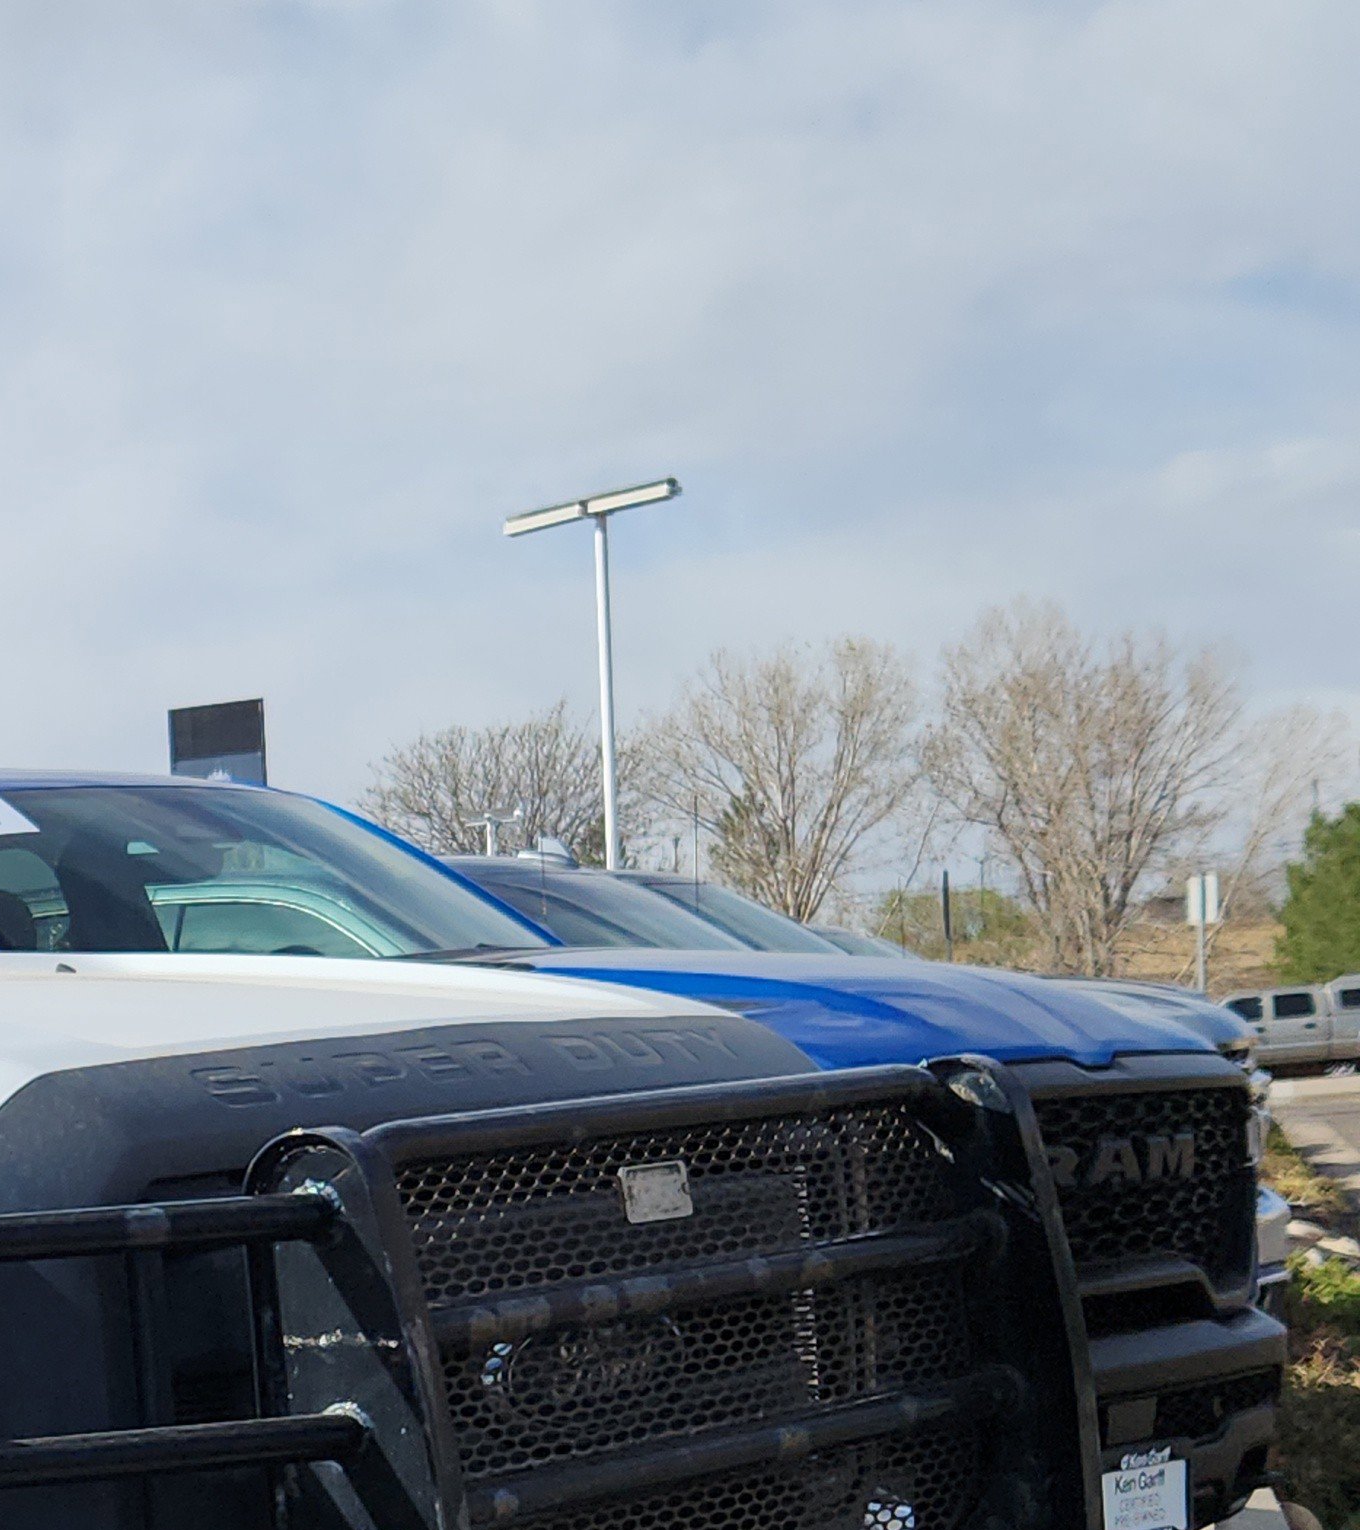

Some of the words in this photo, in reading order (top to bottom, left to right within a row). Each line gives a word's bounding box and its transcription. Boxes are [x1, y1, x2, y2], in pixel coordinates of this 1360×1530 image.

[189, 1039, 532, 1108] SUPER
[540, 1026, 740, 1072] DUTY
[1047, 1132, 1195, 1186] RAM
